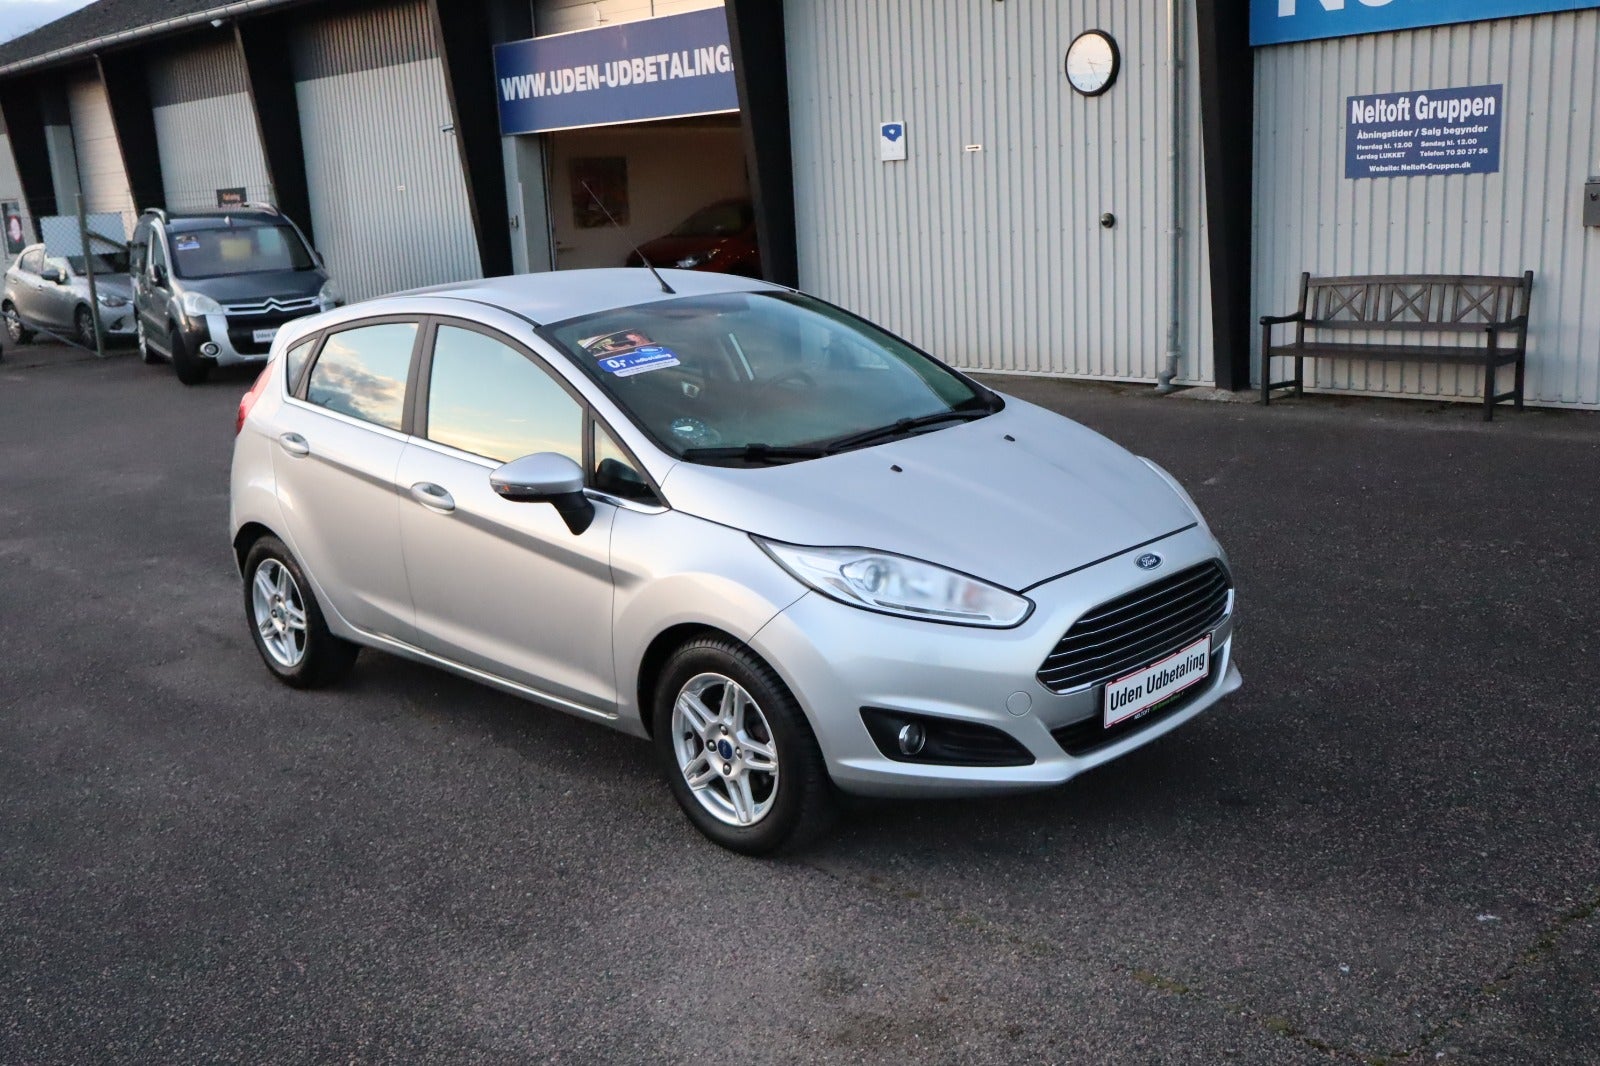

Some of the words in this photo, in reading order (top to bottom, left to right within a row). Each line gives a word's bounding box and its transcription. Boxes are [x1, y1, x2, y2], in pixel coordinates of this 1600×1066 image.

[1352, 96, 1411, 124] Neltoft
[1415, 94, 1496, 123] Gruppen
[1356, 129, 1413, 140] Åbningstider
[1414, 128, 1420, 137] /
[1421, 127, 1441, 136] Salg
[1443, 125, 1489, 136] begynder
[1356, 143, 1383, 151] Hverdag
[1400, 162, 1471, 172] Neltoft-Gruppen.dk
[1110, 684, 1143, 711] Uden
[1146, 652, 1206, 695] Udbetaling
